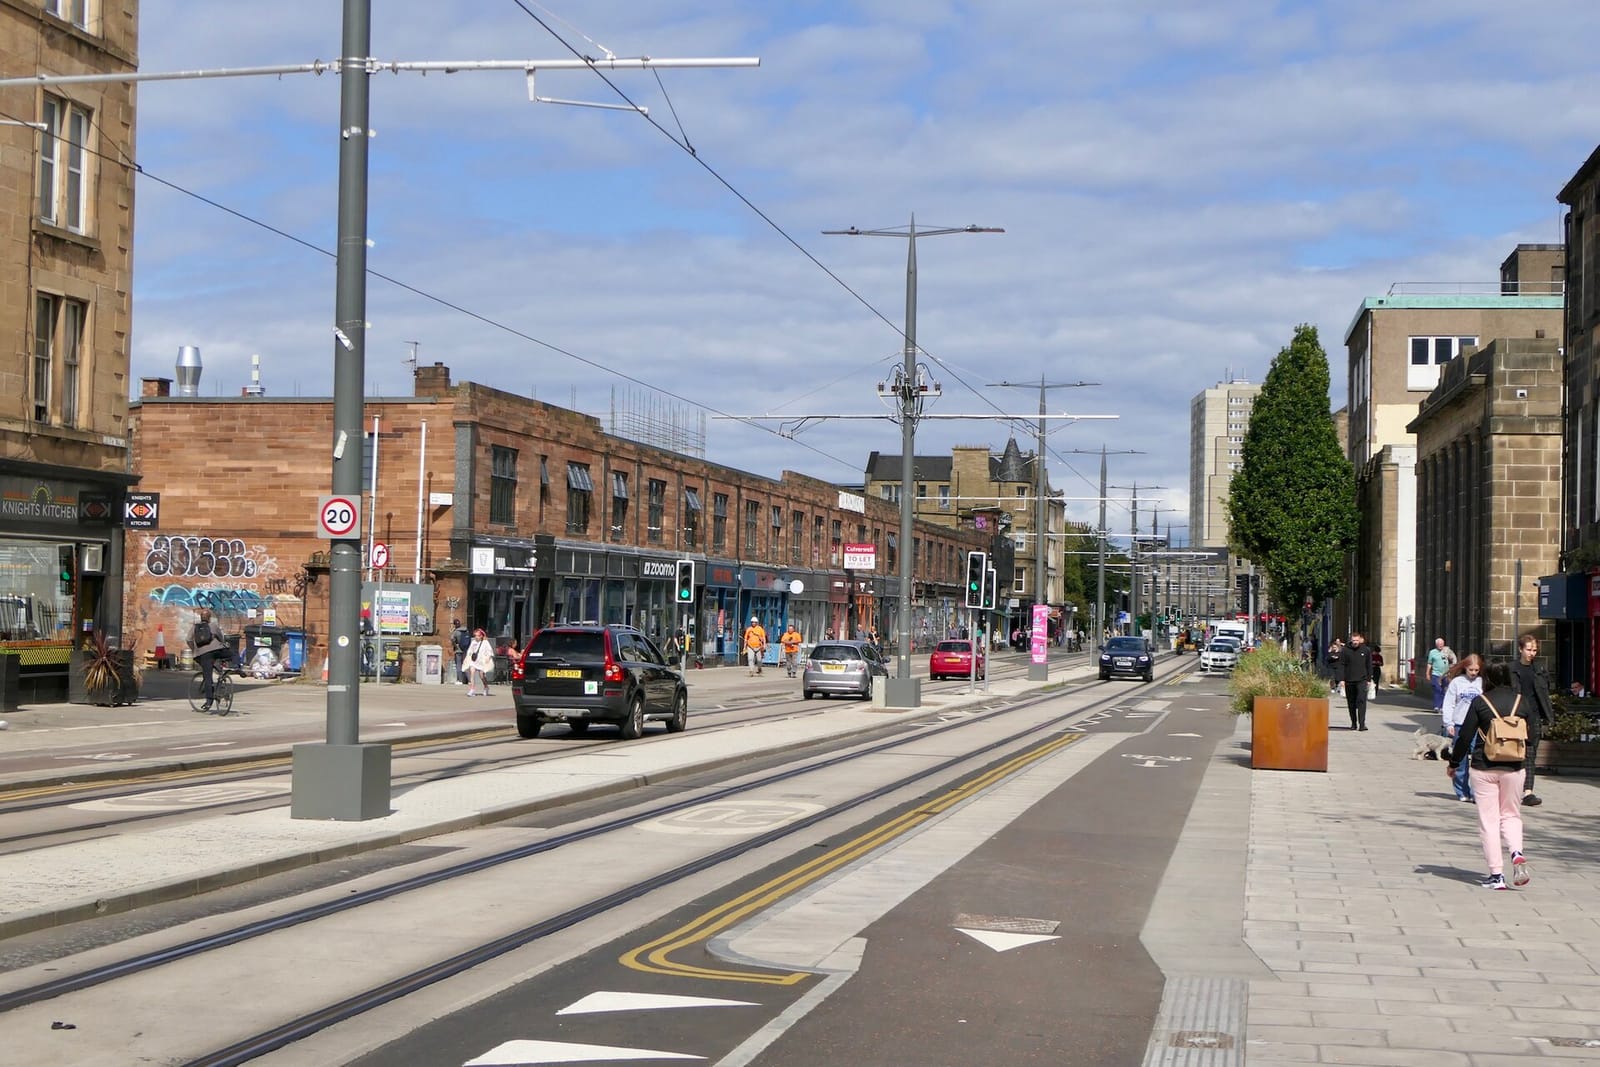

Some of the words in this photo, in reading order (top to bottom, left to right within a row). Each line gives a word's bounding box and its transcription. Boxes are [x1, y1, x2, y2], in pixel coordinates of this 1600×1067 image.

[2, 500, 41, 516] KNIGHTS
[42, 504, 78, 519] KITCHEN
[326, 508, 351, 524] 20
